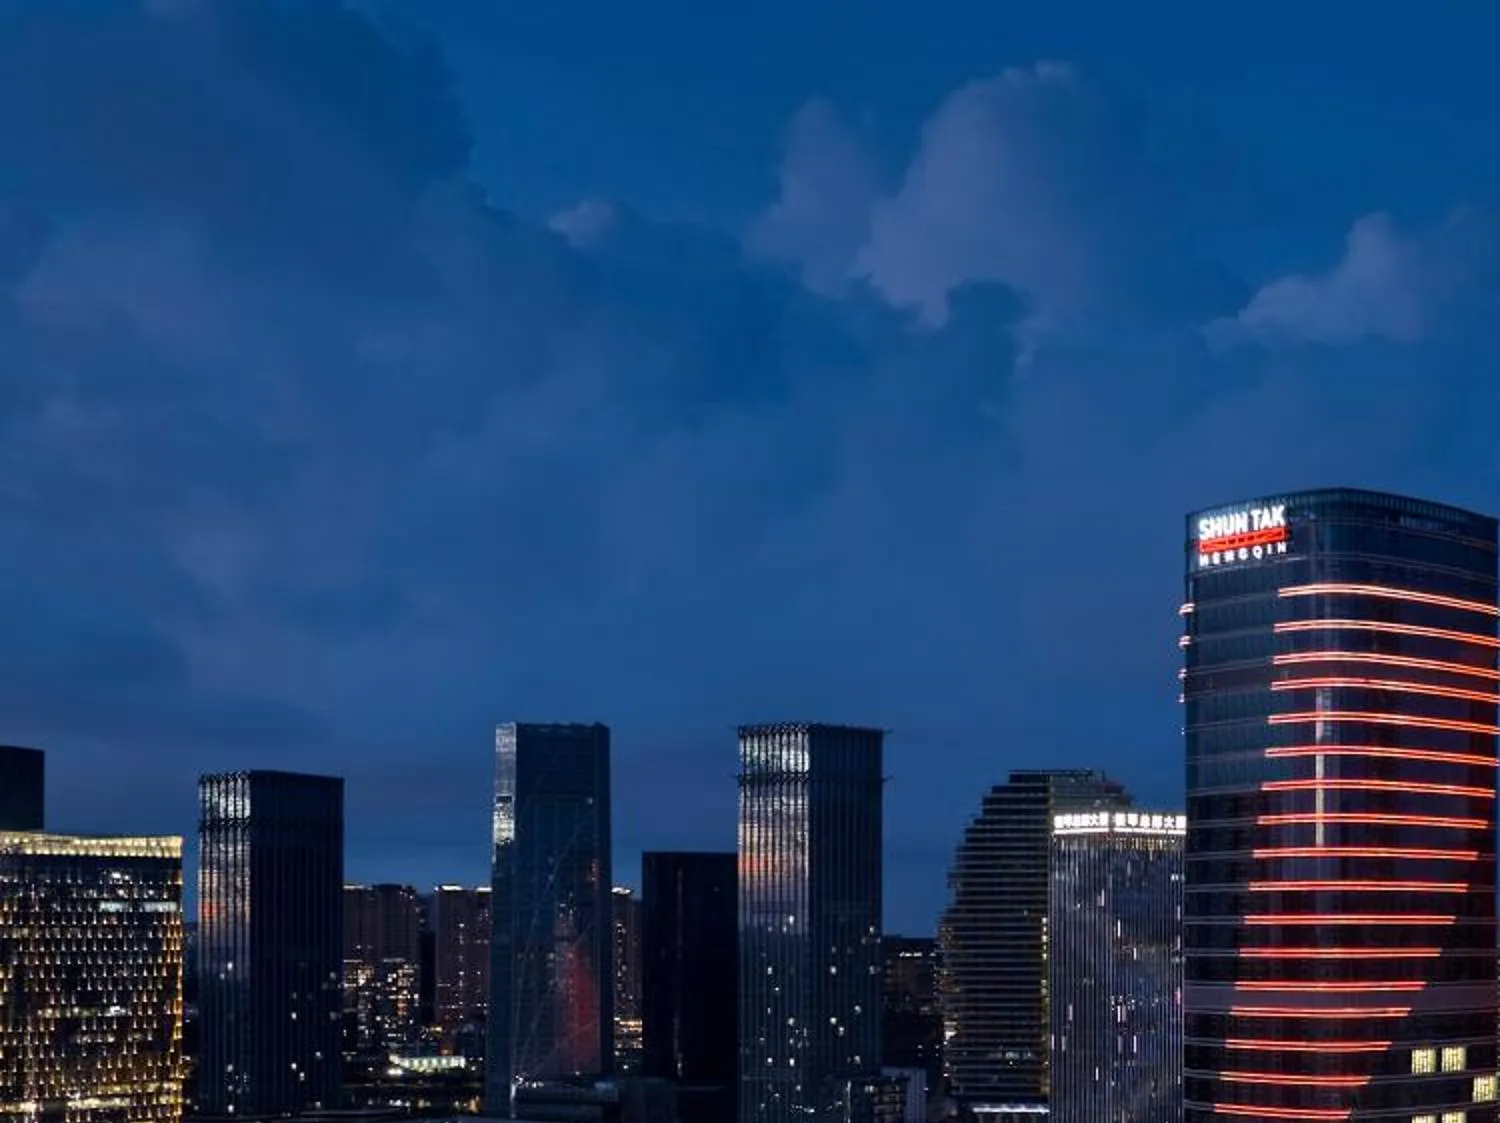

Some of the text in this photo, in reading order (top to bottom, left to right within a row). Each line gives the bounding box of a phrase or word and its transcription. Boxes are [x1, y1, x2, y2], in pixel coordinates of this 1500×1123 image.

[1199, 504, 1285, 541] SHUN TAK
[1199, 541, 1287, 567] HENGQIN
